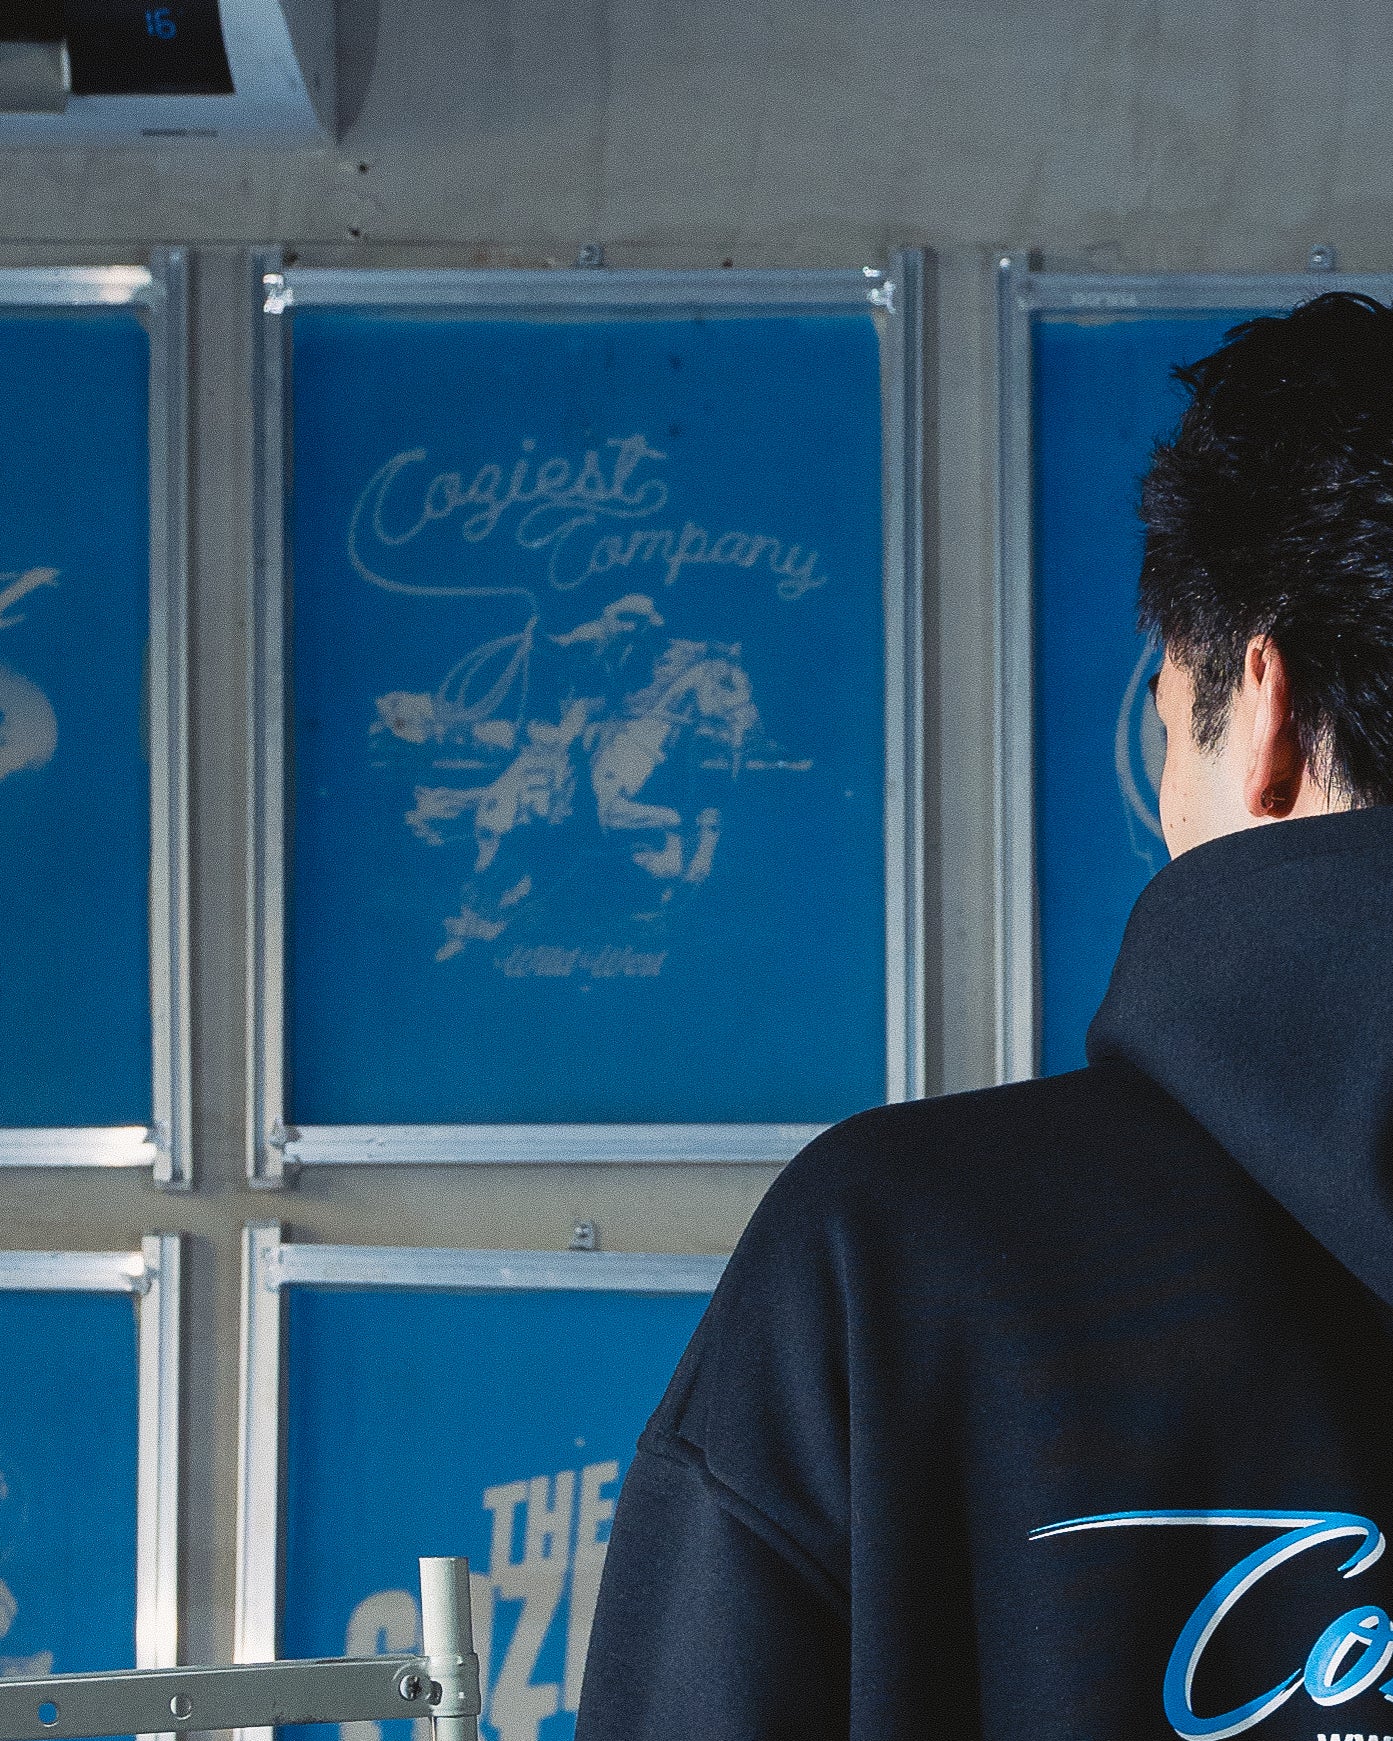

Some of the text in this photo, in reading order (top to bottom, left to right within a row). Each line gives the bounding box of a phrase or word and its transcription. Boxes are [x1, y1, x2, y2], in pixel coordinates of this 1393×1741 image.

[145, 8, 177, 39] 16
[549, 512, 828, 600] Company
[484, 1461, 618, 1565] THE
